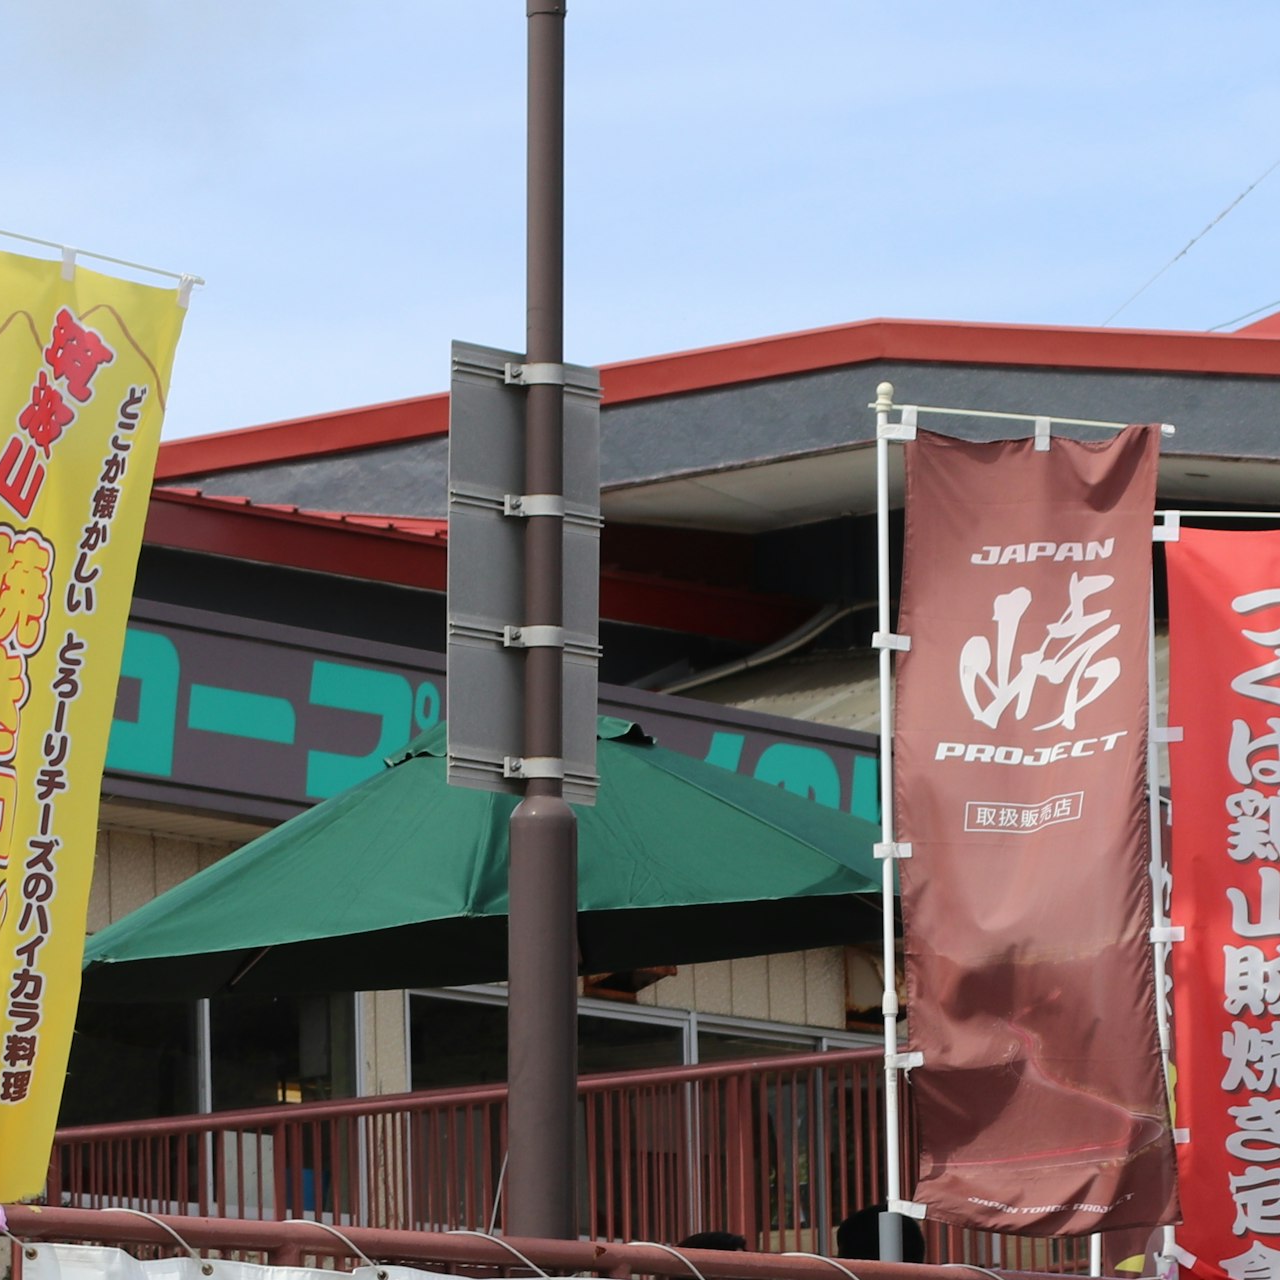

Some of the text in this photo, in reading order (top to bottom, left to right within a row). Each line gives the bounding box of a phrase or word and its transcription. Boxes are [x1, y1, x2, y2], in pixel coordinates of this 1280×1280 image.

[970, 537, 1115, 566] JAPAN
[959, 571, 1121, 731] 峠
[0, 386, 148, 1103] どこか懐かしい とろーりチーズのハイカラ料理
[934, 730, 1128, 767] PROJECT
[976, 795, 1072, 828] 取扱販売店
[967, 1195, 1018, 1214] JAPAN
